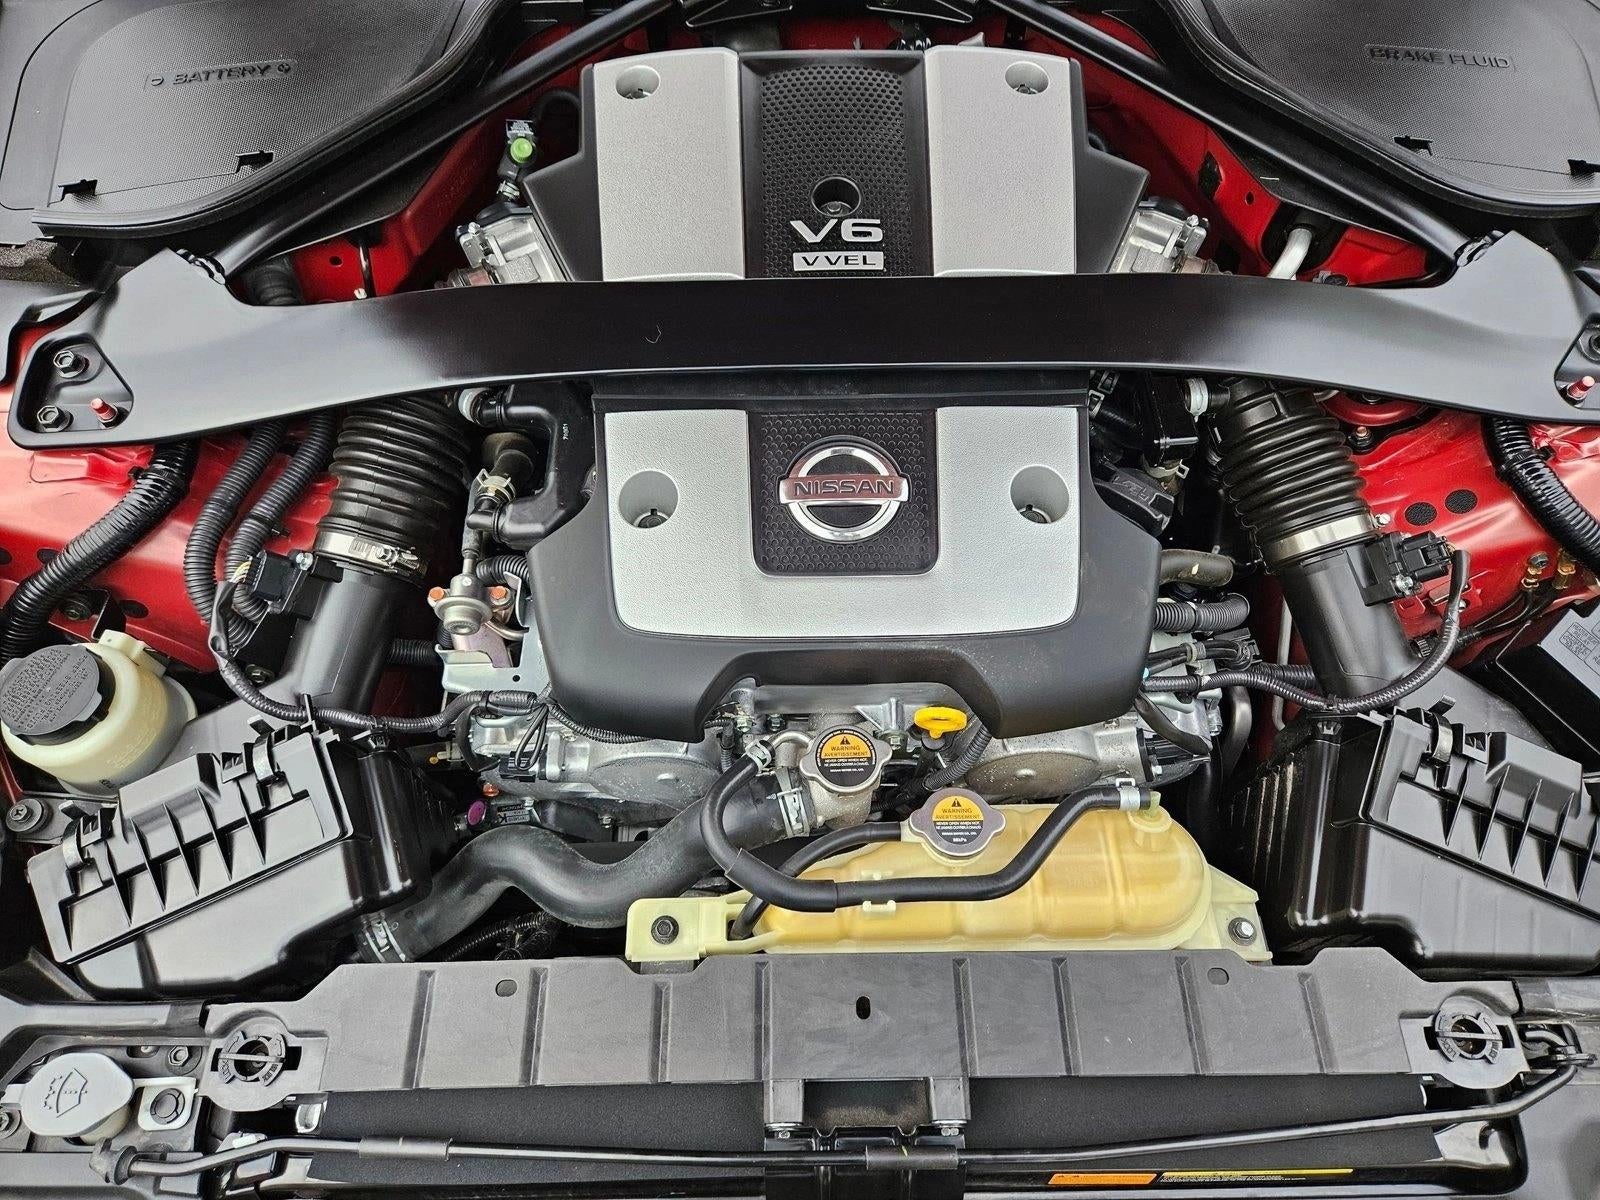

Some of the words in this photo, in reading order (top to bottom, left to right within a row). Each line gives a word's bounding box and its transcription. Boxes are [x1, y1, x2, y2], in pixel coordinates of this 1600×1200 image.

[1370, 48, 1445, 64] BRAKE
[1449, 53, 1511, 69] FLUID
[172, 64, 271, 86] BATTERY
[789, 218, 884, 244] V6
[793, 479, 895, 497] NISSAN
